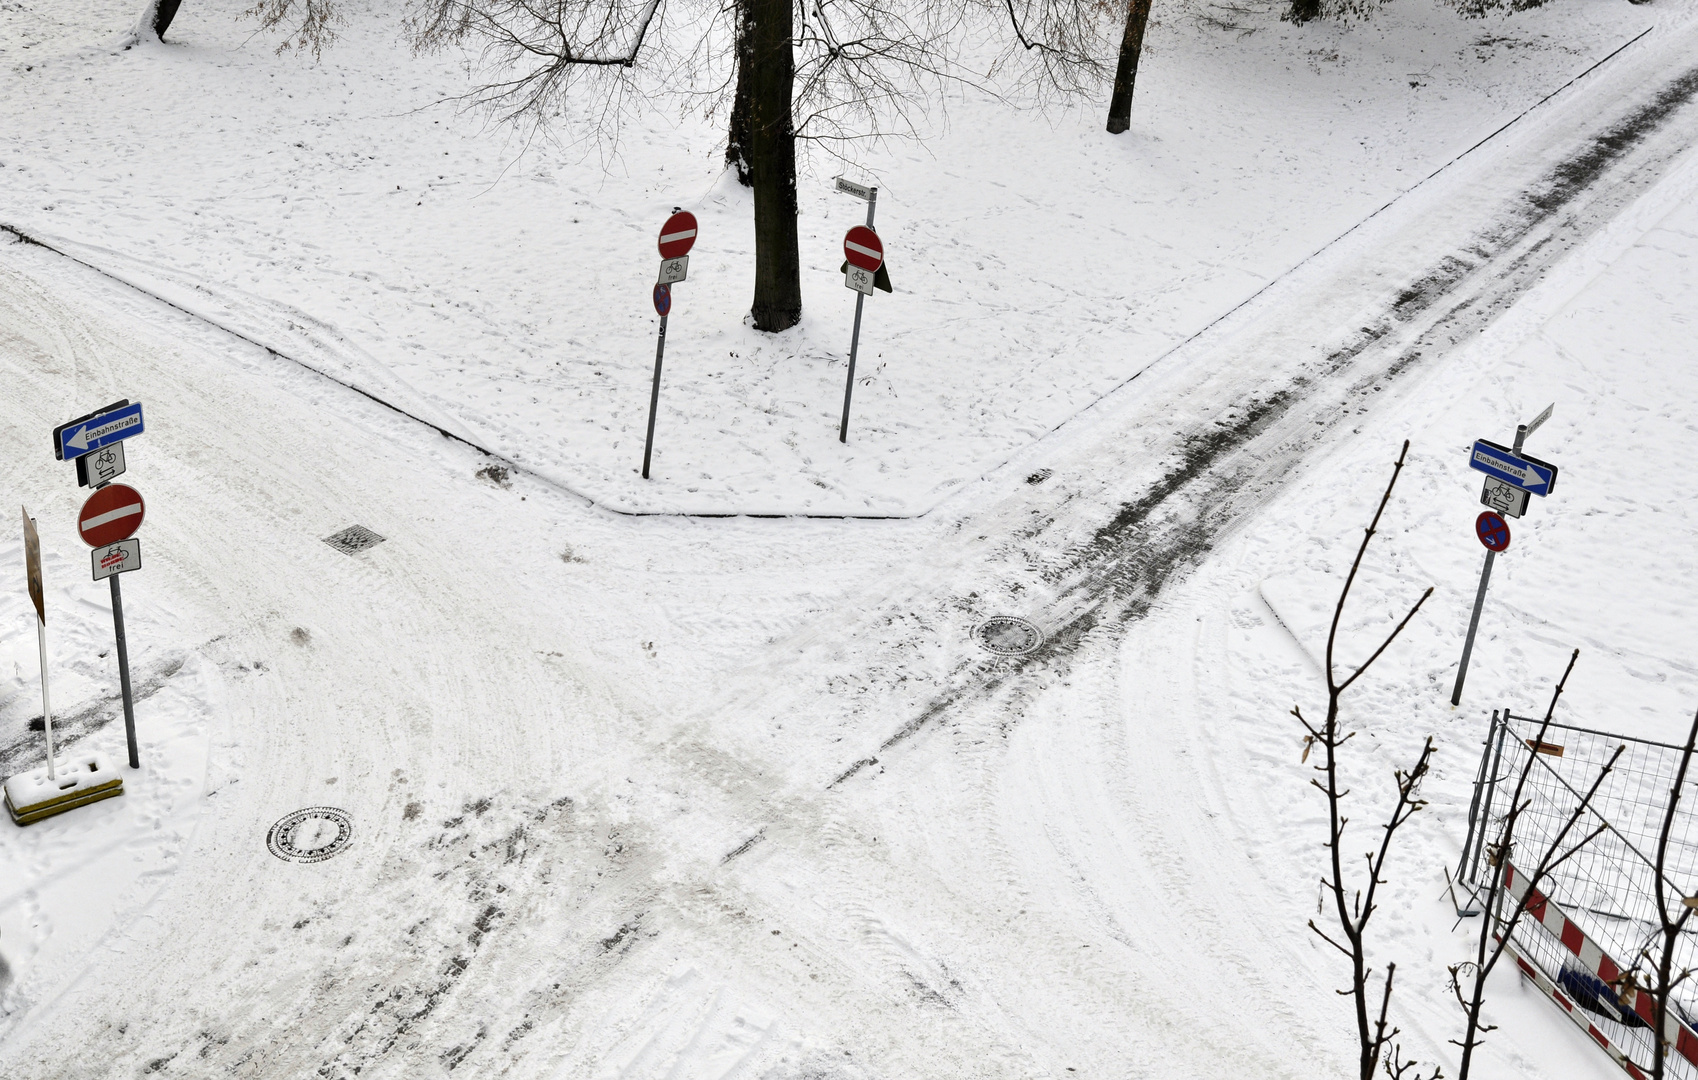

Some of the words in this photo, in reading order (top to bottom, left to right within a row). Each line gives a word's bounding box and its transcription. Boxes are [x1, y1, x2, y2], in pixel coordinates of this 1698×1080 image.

[668, 273, 678, 281] frei
[854, 281, 864, 291] frei
[85, 416, 138, 441] Einbahnstraße
[1475, 452, 1527, 479] Einbahnstraße
[109, 561, 124, 572] frei
